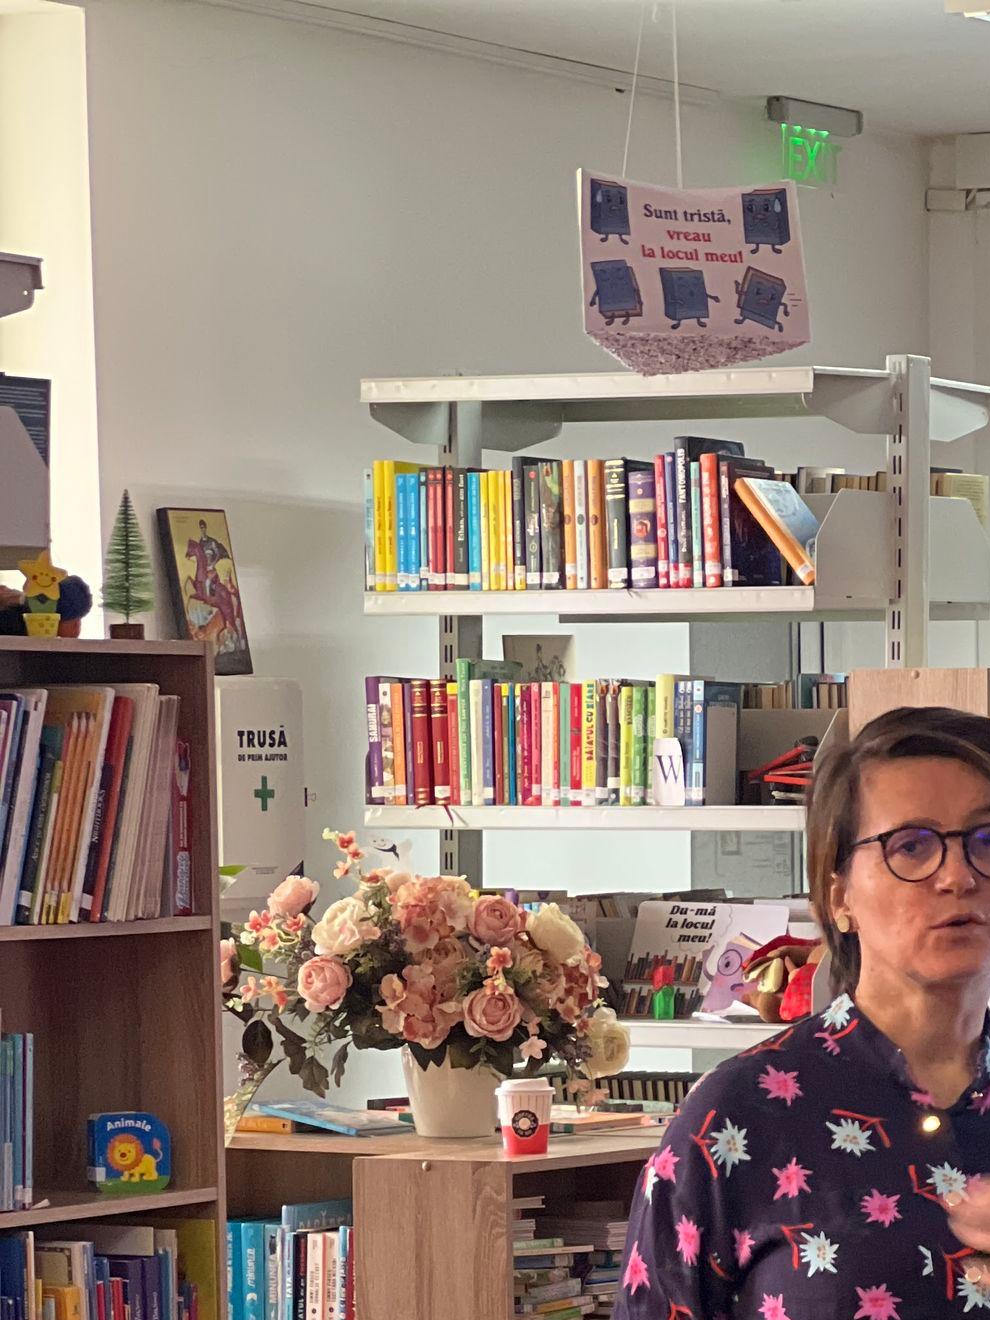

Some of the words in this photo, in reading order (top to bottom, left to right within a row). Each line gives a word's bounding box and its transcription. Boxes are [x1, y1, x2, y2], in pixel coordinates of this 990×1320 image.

[789, 136, 843, 185] EXIT
[643, 203, 678, 221] Sunt
[683, 209, 731, 225] tristă,
[666, 230, 712, 243] vreau
[641, 244, 656, 258] la
[660, 246, 699, 261] locul
[704, 251, 743, 263] meu!
[368, 703, 378, 743] SAMURAI
[586, 711, 594, 723] CU
[238, 754, 246, 762] DE
[264, 753, 288, 761] AJUTOR
[655, 755, 683, 783] W
[665, 917, 679, 928] la
[681, 918, 716, 930] locul
[677, 932, 713, 943] meu!
[106, 1118, 152, 1132] Animale
[268, 1254, 278, 1304] MINUNEA
